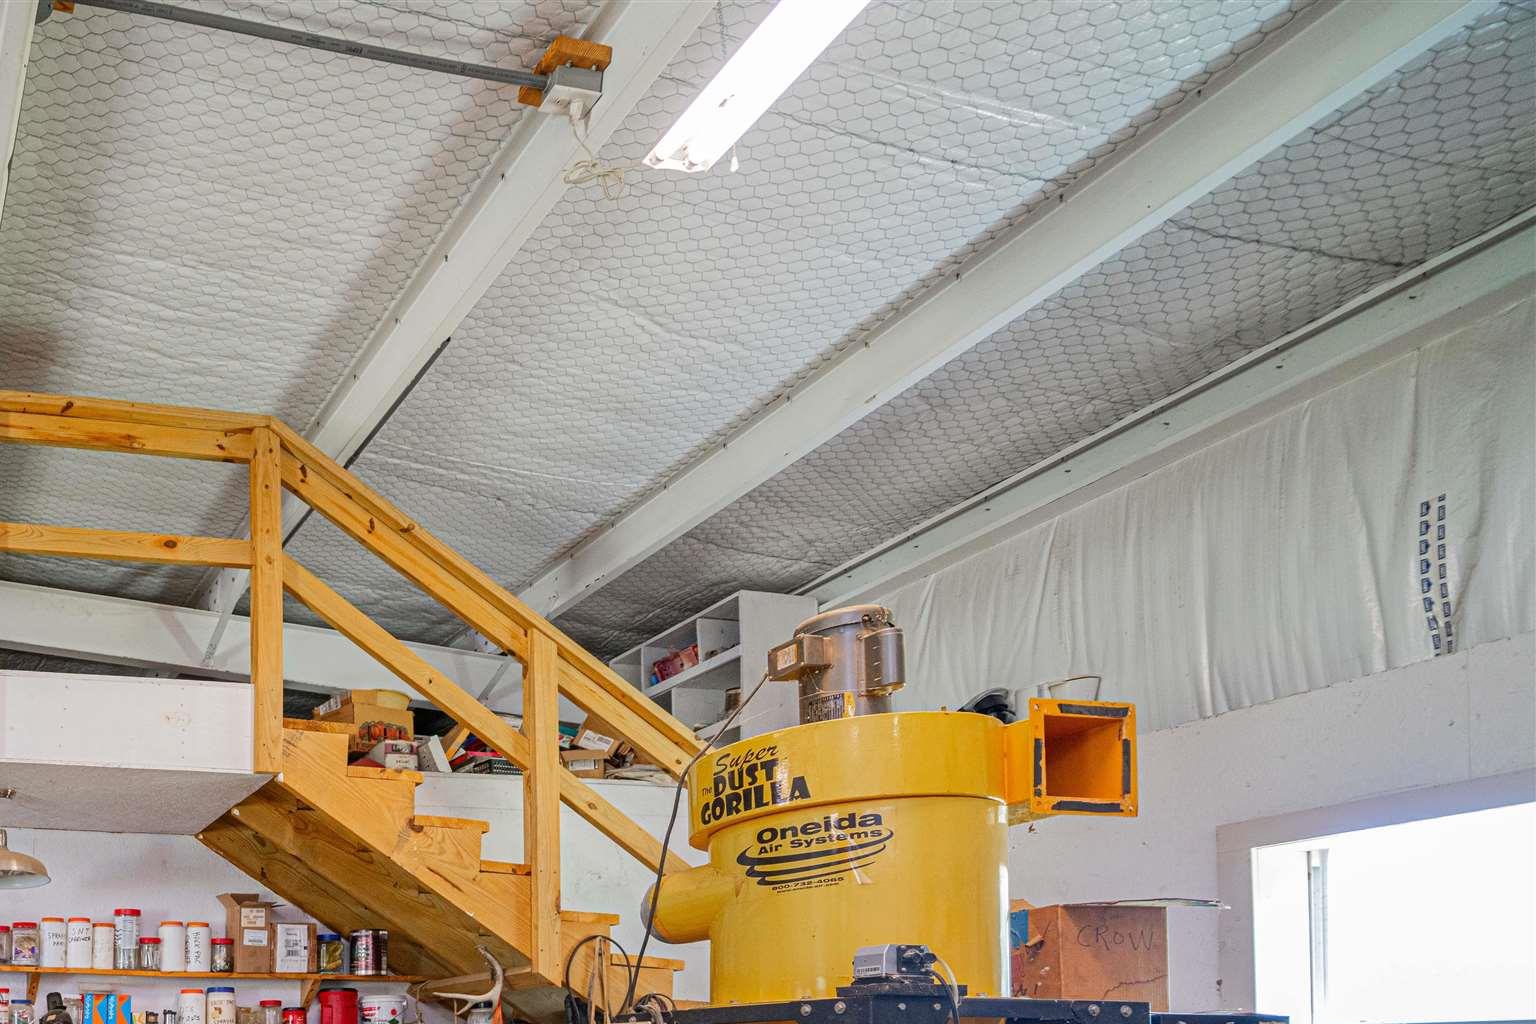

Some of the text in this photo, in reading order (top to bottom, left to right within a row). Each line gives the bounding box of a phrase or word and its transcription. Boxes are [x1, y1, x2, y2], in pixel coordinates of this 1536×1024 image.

[713, 745, 778, 776] Super
[713, 758, 779, 797] DUST
[701, 776, 811, 825] GORILLA
[756, 812, 883, 844] Oneida
[758, 829, 882, 855] Air Systems
[1076, 925, 1154, 950] CROW
